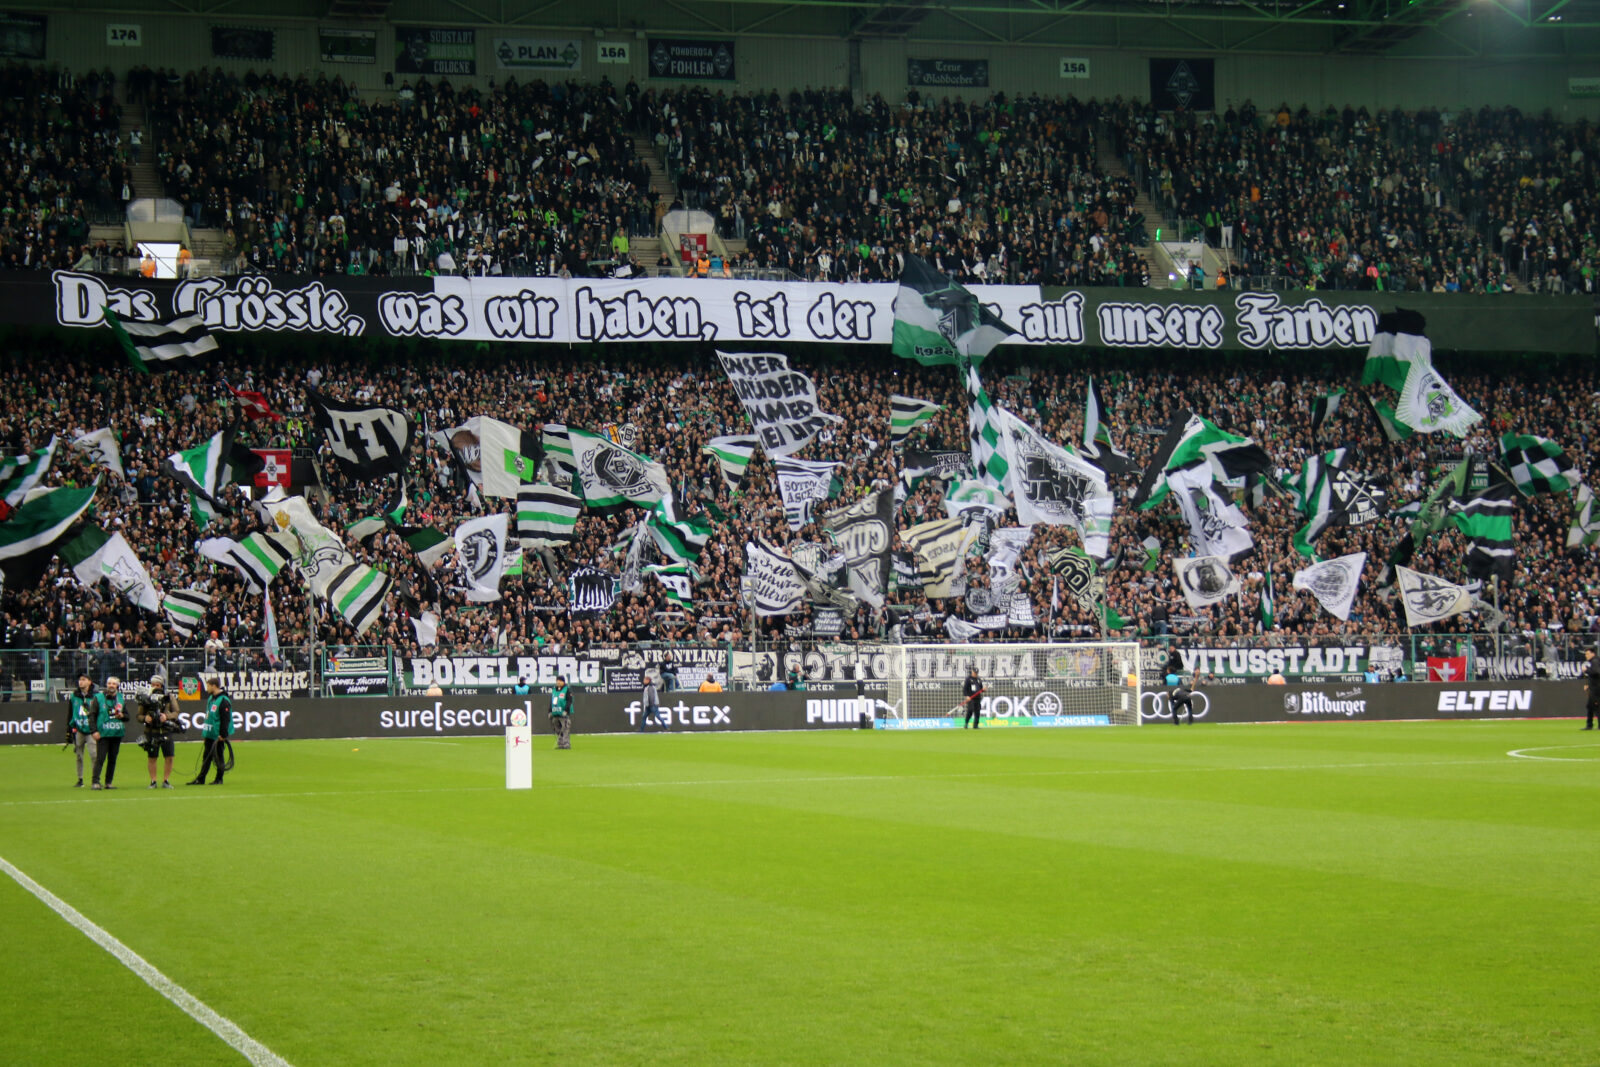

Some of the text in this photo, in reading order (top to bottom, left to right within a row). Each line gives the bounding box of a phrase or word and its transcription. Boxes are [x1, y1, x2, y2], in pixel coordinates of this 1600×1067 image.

[110, 29, 137, 40] 17A
[517, 45, 558, 60] PLAN
[601, 47, 627, 58] 16A
[433, 60, 471, 72] COLOGNE
[670, 60, 715, 76] FOHLEN
[1062, 62, 1087, 73] 15A
[52, 270, 160, 328] Das
[378, 291, 469, 338] was
[485, 289, 560, 339] wir
[576, 286, 719, 342] haben,
[733, 292, 791, 338] ist
[807, 292, 875, 340] der
[1020, 291, 1086, 345] auf
[1097, 302, 1225, 349] unsere
[1235, 292, 1379, 349] Farben
[411, 654, 600, 686] BÖKELBERG
[1177, 647, 1365, 676] VITUSSTADT
[198, 670, 311, 692] WILLICHER
[806, 682, 835, 691] latex
[229, 690, 292, 700] OHLEN
[1437, 690, 1532, 711] ELTEN
[980, 695, 1031, 718] AOK
[1300, 691, 1367, 717] Bitburger
[380, 701, 533, 731] sure[secur]
[625, 701, 732, 726] fatex
[1053, 716, 1095, 725] JONGEN
[0, 717, 53, 734] ander
